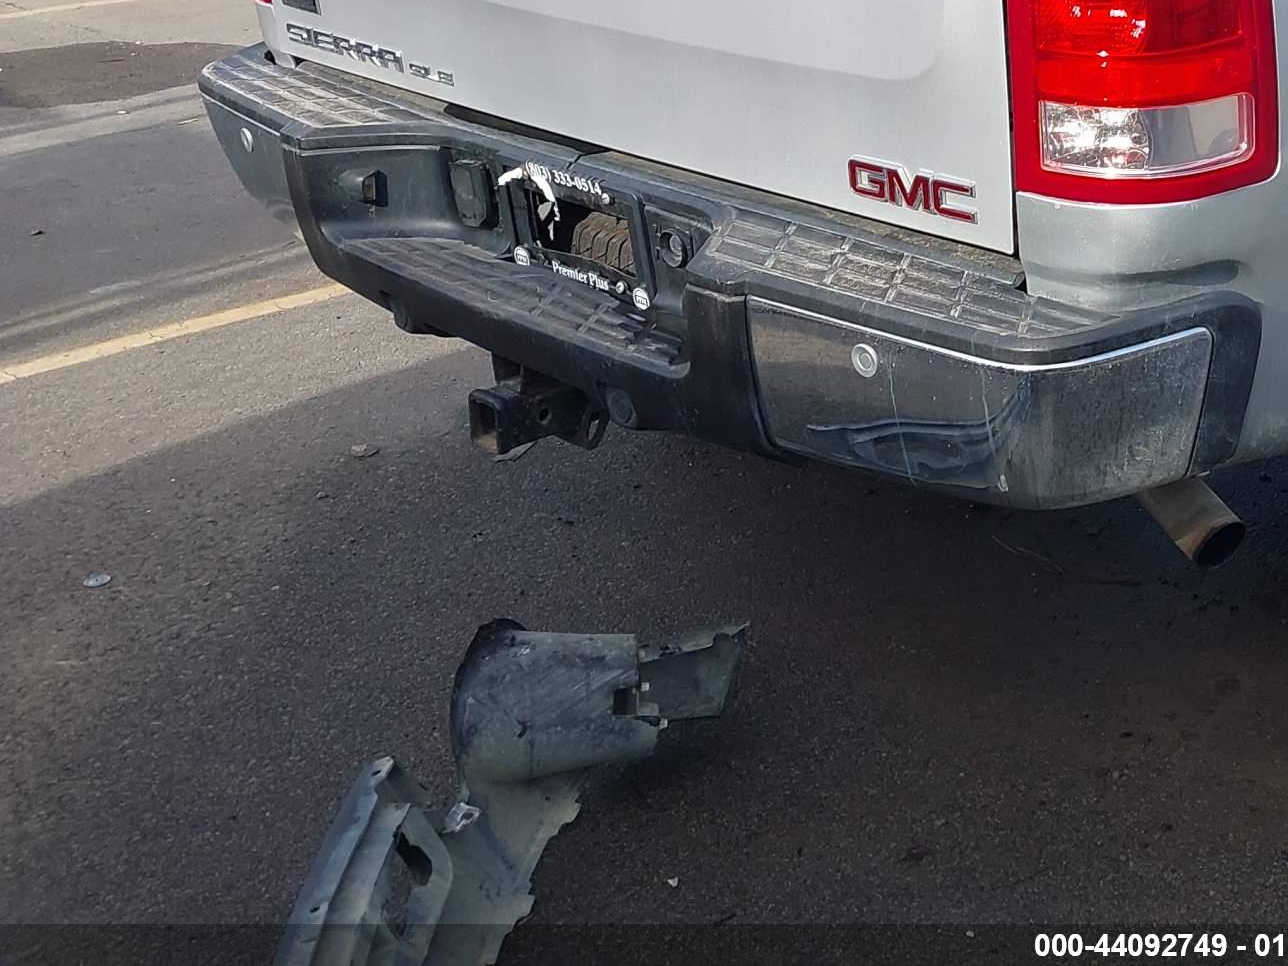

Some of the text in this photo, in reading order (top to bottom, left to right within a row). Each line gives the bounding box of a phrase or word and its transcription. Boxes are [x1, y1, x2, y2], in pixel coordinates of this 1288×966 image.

[286, 22, 405, 74] SIERRA
[408, 63, 455, 88] SLE
[552, 169, 602, 196] 333-0514
[847, 154, 979, 225] GMC
[551, 259, 611, 291] Premier Plus
